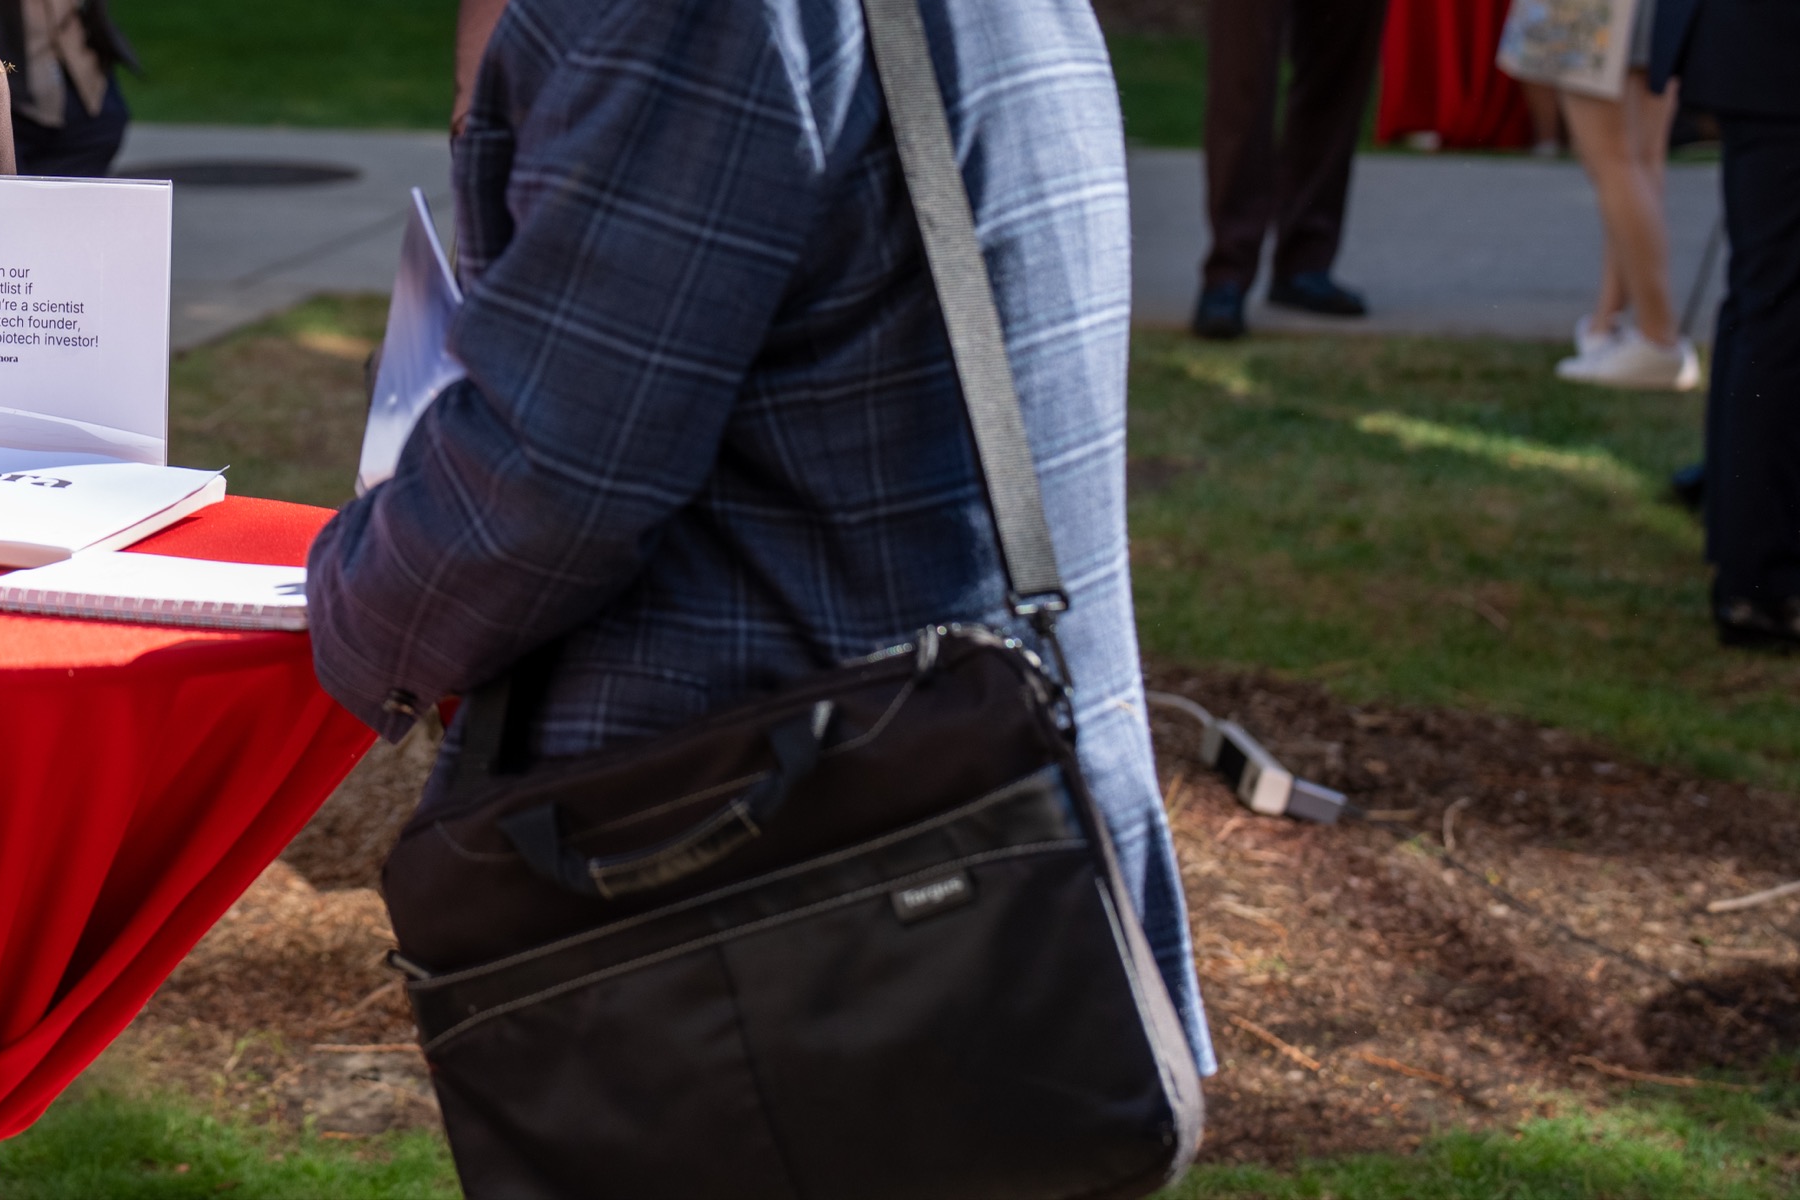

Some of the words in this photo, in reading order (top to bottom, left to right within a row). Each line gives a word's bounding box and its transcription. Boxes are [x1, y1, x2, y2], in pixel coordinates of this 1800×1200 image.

[9, 267, 30, 279] our
[25, 282, 33, 295] if
[21, 301, 29, 312] a
[32, 300, 85, 314] scientist
[28, 316, 81, 333] founder,
[44, 333, 99, 348] investor!
